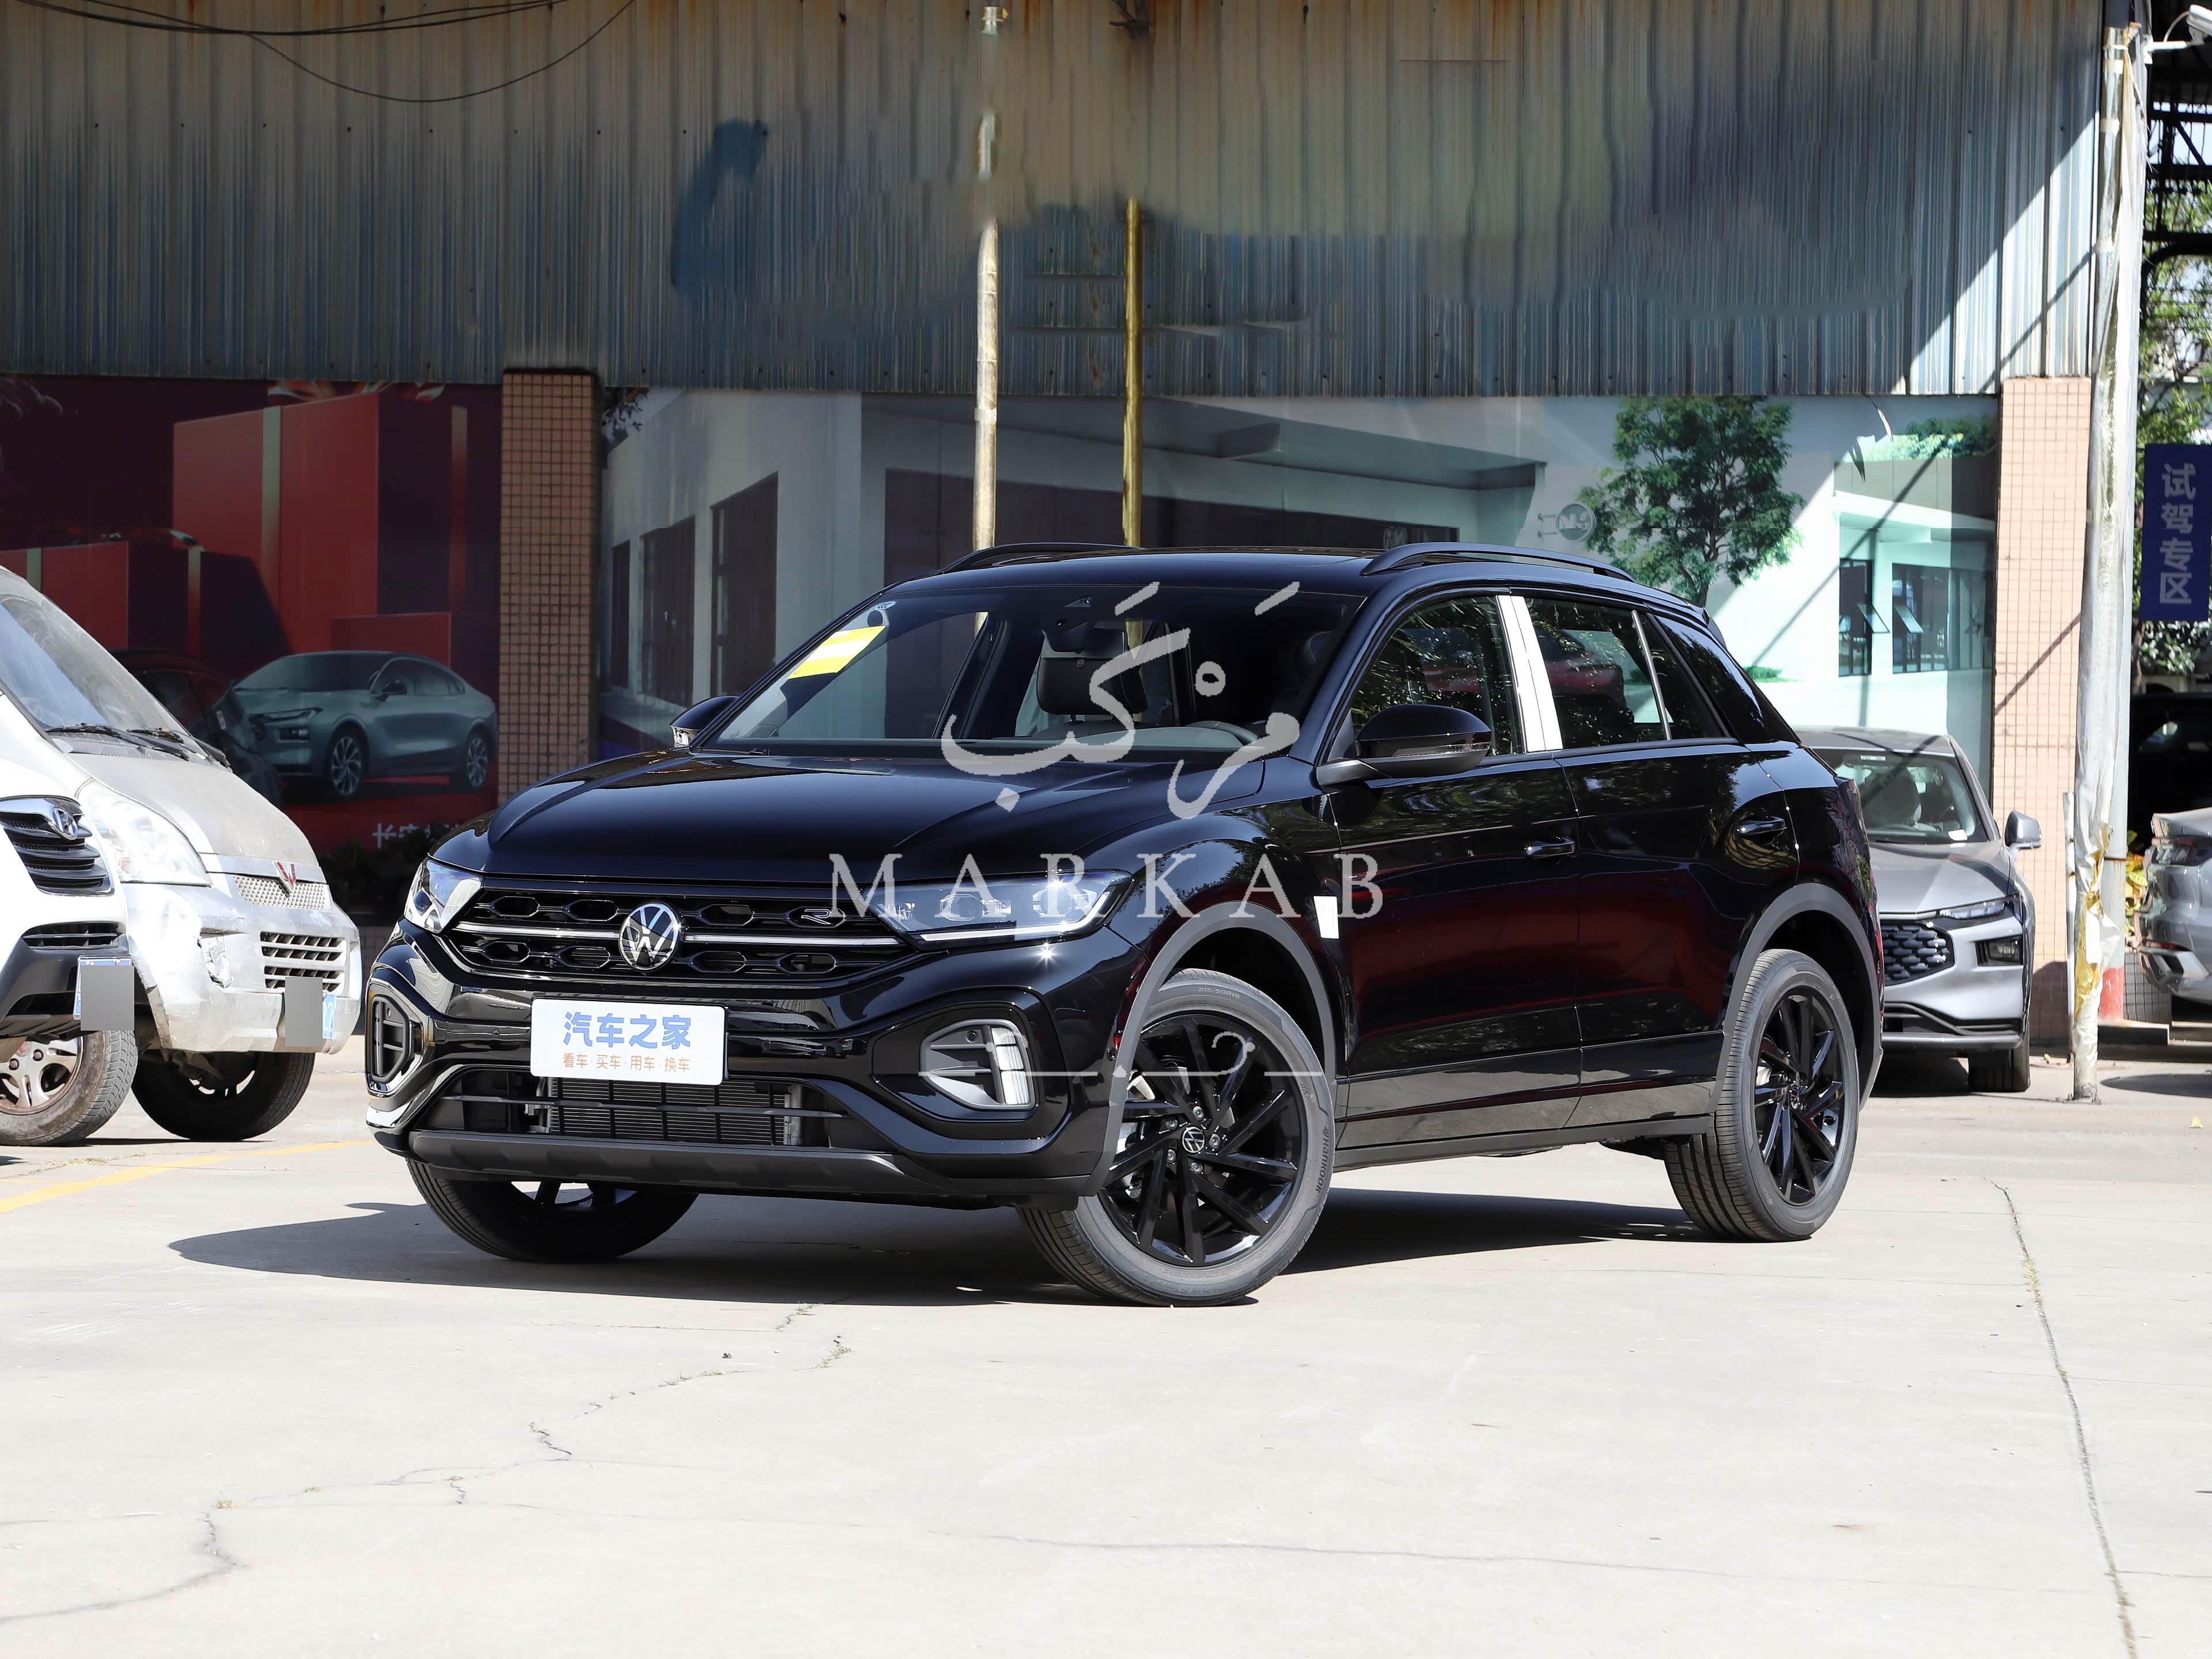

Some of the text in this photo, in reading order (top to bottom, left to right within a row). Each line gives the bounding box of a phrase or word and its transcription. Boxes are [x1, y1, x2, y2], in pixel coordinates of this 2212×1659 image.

[2160, 463, 2196, 604] 试驾专区
[1197, 986, 1240, 999] 215/50R18
[563, 1012, 692, 1050] 汽车之家
